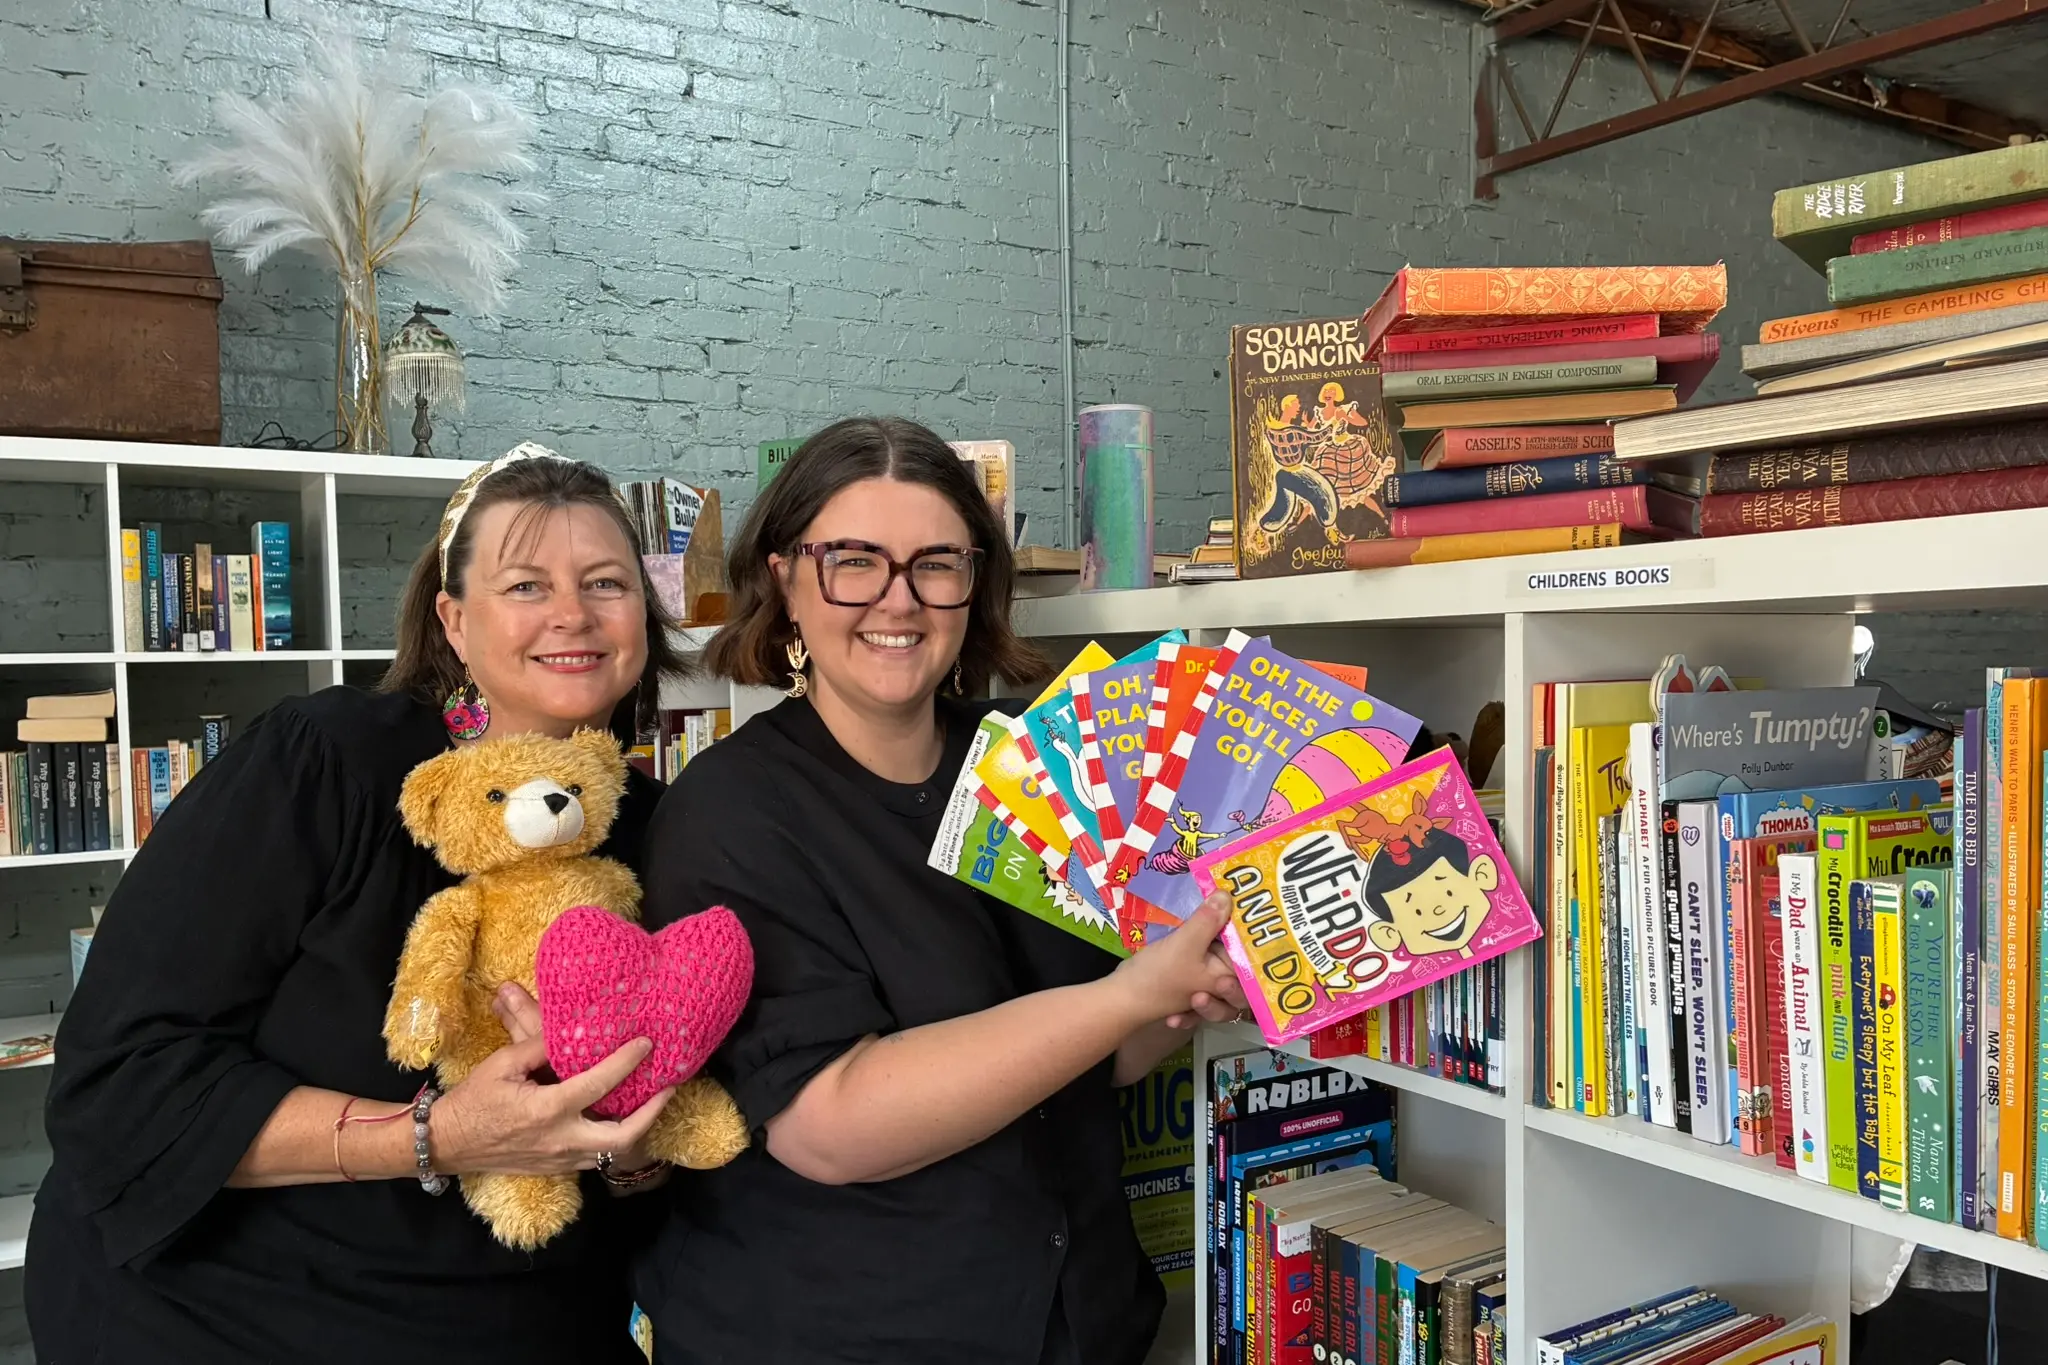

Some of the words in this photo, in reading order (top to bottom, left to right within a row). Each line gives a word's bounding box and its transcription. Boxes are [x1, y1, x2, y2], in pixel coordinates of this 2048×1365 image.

[1805, 193, 1814, 211] THE
[1816, 184, 1832, 219] RIDGE
[1848, 181, 1866, 214] RIVER
[1905, 253, 1966, 272] KIPLING
[1973, 240, 2045, 262] RUDYARD
[1767, 317, 1839, 339] Stivens
[1858, 307, 1892, 323] THE
[1905, 288, 2004, 315] GAMBLING
[1246, 319, 1361, 355] SQUARE
[1427, 338, 1458, 349] PART
[1476, 330, 1563, 345] MATHEMATICS
[1572, 323, 1626, 337] LEAVING
[1417, 376, 1441, 386] ORAL
[1444, 373, 1495, 385] EXERCISES
[1498, 372, 1508, 382] IN
[1512, 369, 1553, 381] ENGLISH
[1557, 365, 1622, 378] COMPOSITION
[1465, 438, 1521, 451] CASSELL'S
[1749, 456, 1760, 479] THE
[1803, 448, 1821, 482] WAR
[1821, 454, 1830, 466] IN
[1500, 465, 1508, 495] MUSEUM
[1743, 501, 1752, 524] THE
[1754, 495, 1768, 528] FIRST
[1770, 491, 1785, 528] YEAR
[1785, 501, 1794, 517] OF
[1795, 490, 1812, 525] WAR
[1813, 500, 1821, 512] IN
[183, 556, 193, 581] COLIN
[1528, 571, 1606, 590] CHILDRENS
[1615, 567, 1669, 585] BOOKS
[184, 583, 194, 612] DEXTER
[1185, 659, 1205, 674] Dr.
[1103, 675, 1147, 699] OH,
[1250, 656, 1291, 691] OH,
[1294, 677, 1344, 718] THE
[1225, 673, 1320, 737] PLACES
[205, 721, 218, 752] GORDON
[1213, 699, 1292, 759] YOU'LL
[1671, 723, 1743, 748] Where's
[1749, 706, 1869, 751] Tumpty?
[2009, 704, 2018, 745] HENRI'S
[1216, 735, 1263, 771] GO!
[2009, 749, 2018, 775] WALK
[39, 763, 48, 781] Fifty
[67, 761, 76, 780] Fifty
[92, 761, 100, 780] Fifty
[1741, 762, 1762, 775] Polly
[1764, 761, 1794, 773] Dunbar
[40, 782, 49, 809] Shades
[68, 781, 76, 808] Shades
[94, 781, 102, 808] Shades
[1966, 772, 1976, 805] TIME
[2009, 778, 2018, 790] TO
[1639, 789, 1649, 849] ALPHABET
[1933, 817, 1949, 828] PULL
[1966, 809, 1976, 835] FOR
[2008, 793, 2018, 823] PARIS
[1761, 816, 1809, 835] THOMAS
[1004, 851, 1026, 880] ON
[1642, 855, 1649, 864] A
[1828, 858, 1839, 872] My
[1965, 841, 1976, 866] BED
[2008, 832, 2017, 897] ILLUSTRATED
[1643, 866, 1651, 883] FUN
[1790, 882, 1801, 896] My
[1644, 887, 1653, 932] CHANGING
[1688, 881, 1701, 935] CAN'T
[1788, 896, 1806, 929] Dad
[1827, 872, 1844, 948] Crocodile
[2008, 899, 2016, 911] BY
[1223, 865, 1288, 948] ANH
[1262, 950, 1316, 1016] DO
[1281, 884, 1308, 931] HOPPING
[1298, 930, 1328, 971] WEIRD!
[1622, 927, 1628, 938] AT
[1794, 930, 1802, 951] were
[1909, 924, 1920, 950] FOR
[2008, 914, 2016, 940] SAUL
[1647, 935, 1656, 979] PICTURES
[1691, 938, 1703, 991] SLEEP.
[1795, 953, 1801, 963] an
[1926, 931, 1943, 999] YOU'RE
[1966, 952, 1975, 975] Mem
[2007, 944, 2016, 970] BASS
[1314, 960, 1358, 1002] 12
[1829, 963, 1847, 999] pink
[2007, 979, 2016, 1010] STORY
[1735, 929, 1743, 957] NODDY
[1740, 1039, 1748, 1079] RUBBER
[1792, 962, 1810, 1033] Animal
[1834, 1000, 1842, 1014] AND
[1910, 972, 1924, 1047] REASON
[1967, 993, 1975, 1001] &
[1693, 995, 1705, 1052] WON'T
[1882, 1013, 1894, 1034] On
[1928, 1005, 1939, 1040] HERE
[1965, 1003, 1975, 1023] Jane
[2007, 1013, 2015, 1026] BY
[1831, 1015, 1849, 1062] fluffy
[1857, 1025, 1875, 1065] sleepy
[1967, 1024, 1975, 1045] Dyer
[1988, 1030, 1999, 1062] MAY
[1880, 1040, 1894, 1061] My
[2005, 1029, 2015, 1075] LEONORE
[1248, 1071, 1368, 1114] ROBLOX
[1694, 1053, 1708, 1109] SLEEP.
[1779, 1052, 1791, 1109] London
[1862, 1068, 1878, 1090] but
[1883, 1064, 1896, 1097] Leaf
[1988, 1065, 1999, 1106] GIBBS
[2005, 1078, 2014, 1106] KLEIN
[1865, 1092, 1879, 1115] the
[1283, 1123, 1301, 1134] 100%
[1302, 1115, 1340, 1130] UNOFFICIAL
[1858, 1118, 1879, 1149] Baby
[1831, 1149, 1857, 1164] believe
[1835, 1161, 1855, 1172] ideas
[1912, 1129, 1925, 1182] Tillman
[1927, 1136, 1943, 1184] Nancy
[1218, 1200, 1226, 1249] ROBLOX
[1219, 1267, 1227, 1303] MEGA
[1313, 1264, 1324, 1303] WOLF
[1330, 1271, 1341, 1311] WOLF
[1345, 1277, 1355, 1316] WOLF
[1219, 1305, 1227, 1333] HITS
[1313, 1309, 1324, 1338] GIRL
[1330, 1316, 1341, 1346] GIRL
[1345, 1321, 1356, 1352] GIRL
[1317, 1348, 1321, 1356] 1
[1334, 1356, 1339, 1364] 2
